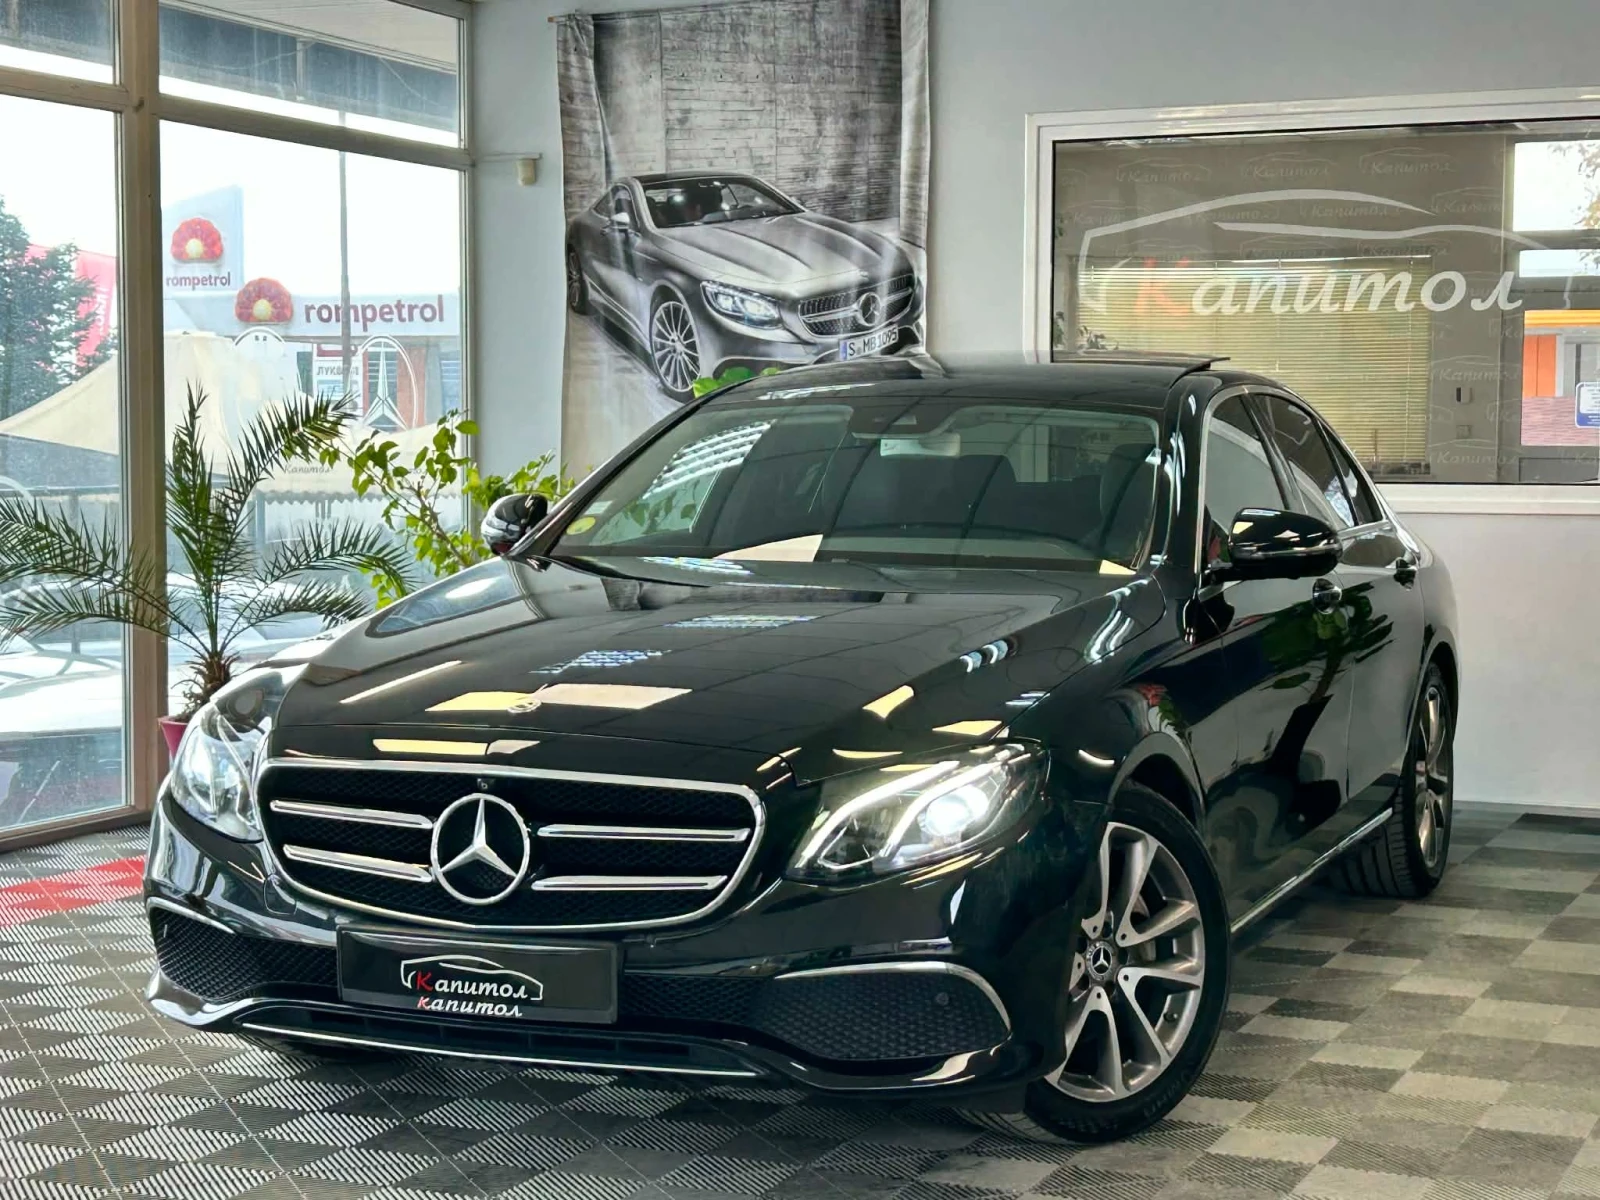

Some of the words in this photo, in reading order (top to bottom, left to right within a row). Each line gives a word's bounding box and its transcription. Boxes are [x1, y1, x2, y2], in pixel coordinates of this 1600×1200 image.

[165, 272, 231, 291] rompetrol
[1134, 256, 1523, 315] Капитол
[304, 294, 445, 332] rompetrol
[848, 342, 856, 356] S
[416, 971, 528, 998] Капитол
